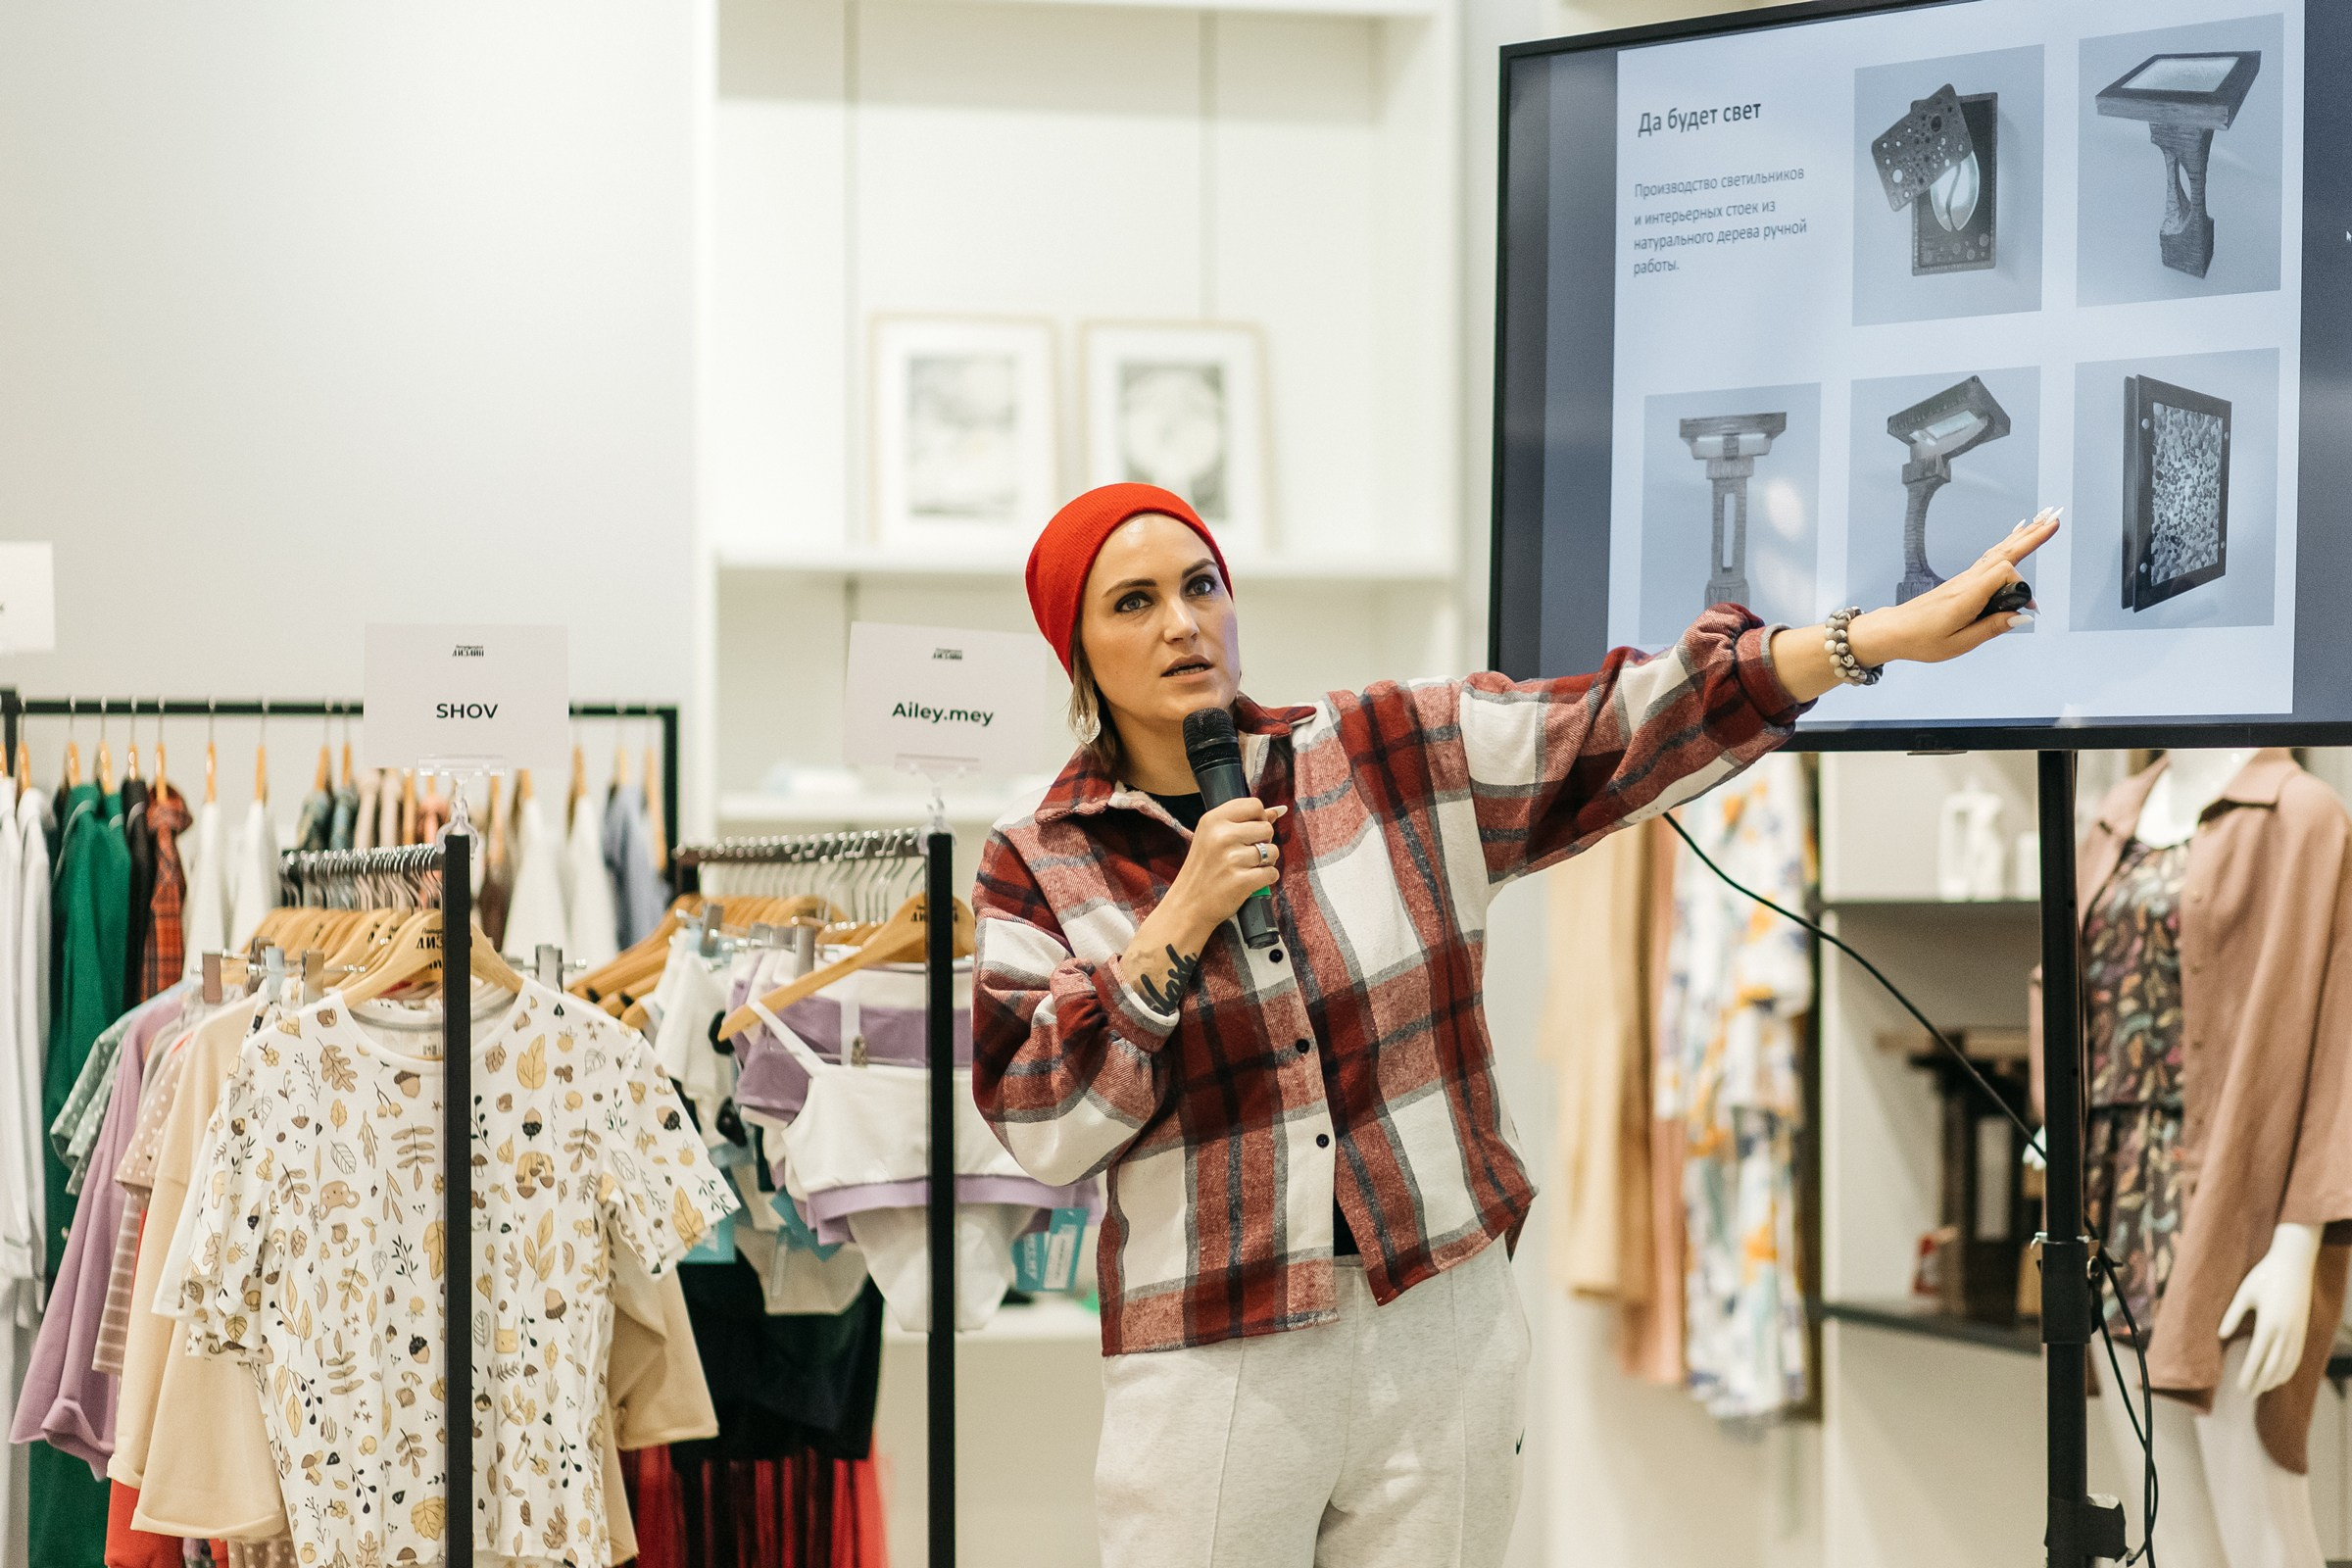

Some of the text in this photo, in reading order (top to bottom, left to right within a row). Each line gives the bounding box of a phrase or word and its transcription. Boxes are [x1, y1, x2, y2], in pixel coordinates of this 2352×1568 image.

[1638, 102, 1761, 137] Да будет свет
[1634, 168, 1804, 200] Производство светильников
[1634, 200, 1776, 226] и интерьерных стоек из
[1634, 219, 1807, 252] натурального дерева ручной
[1634, 258, 1680, 277] работы.
[436, 703, 499, 719] SHOV
[892, 702, 994, 727] Ailey.mey
